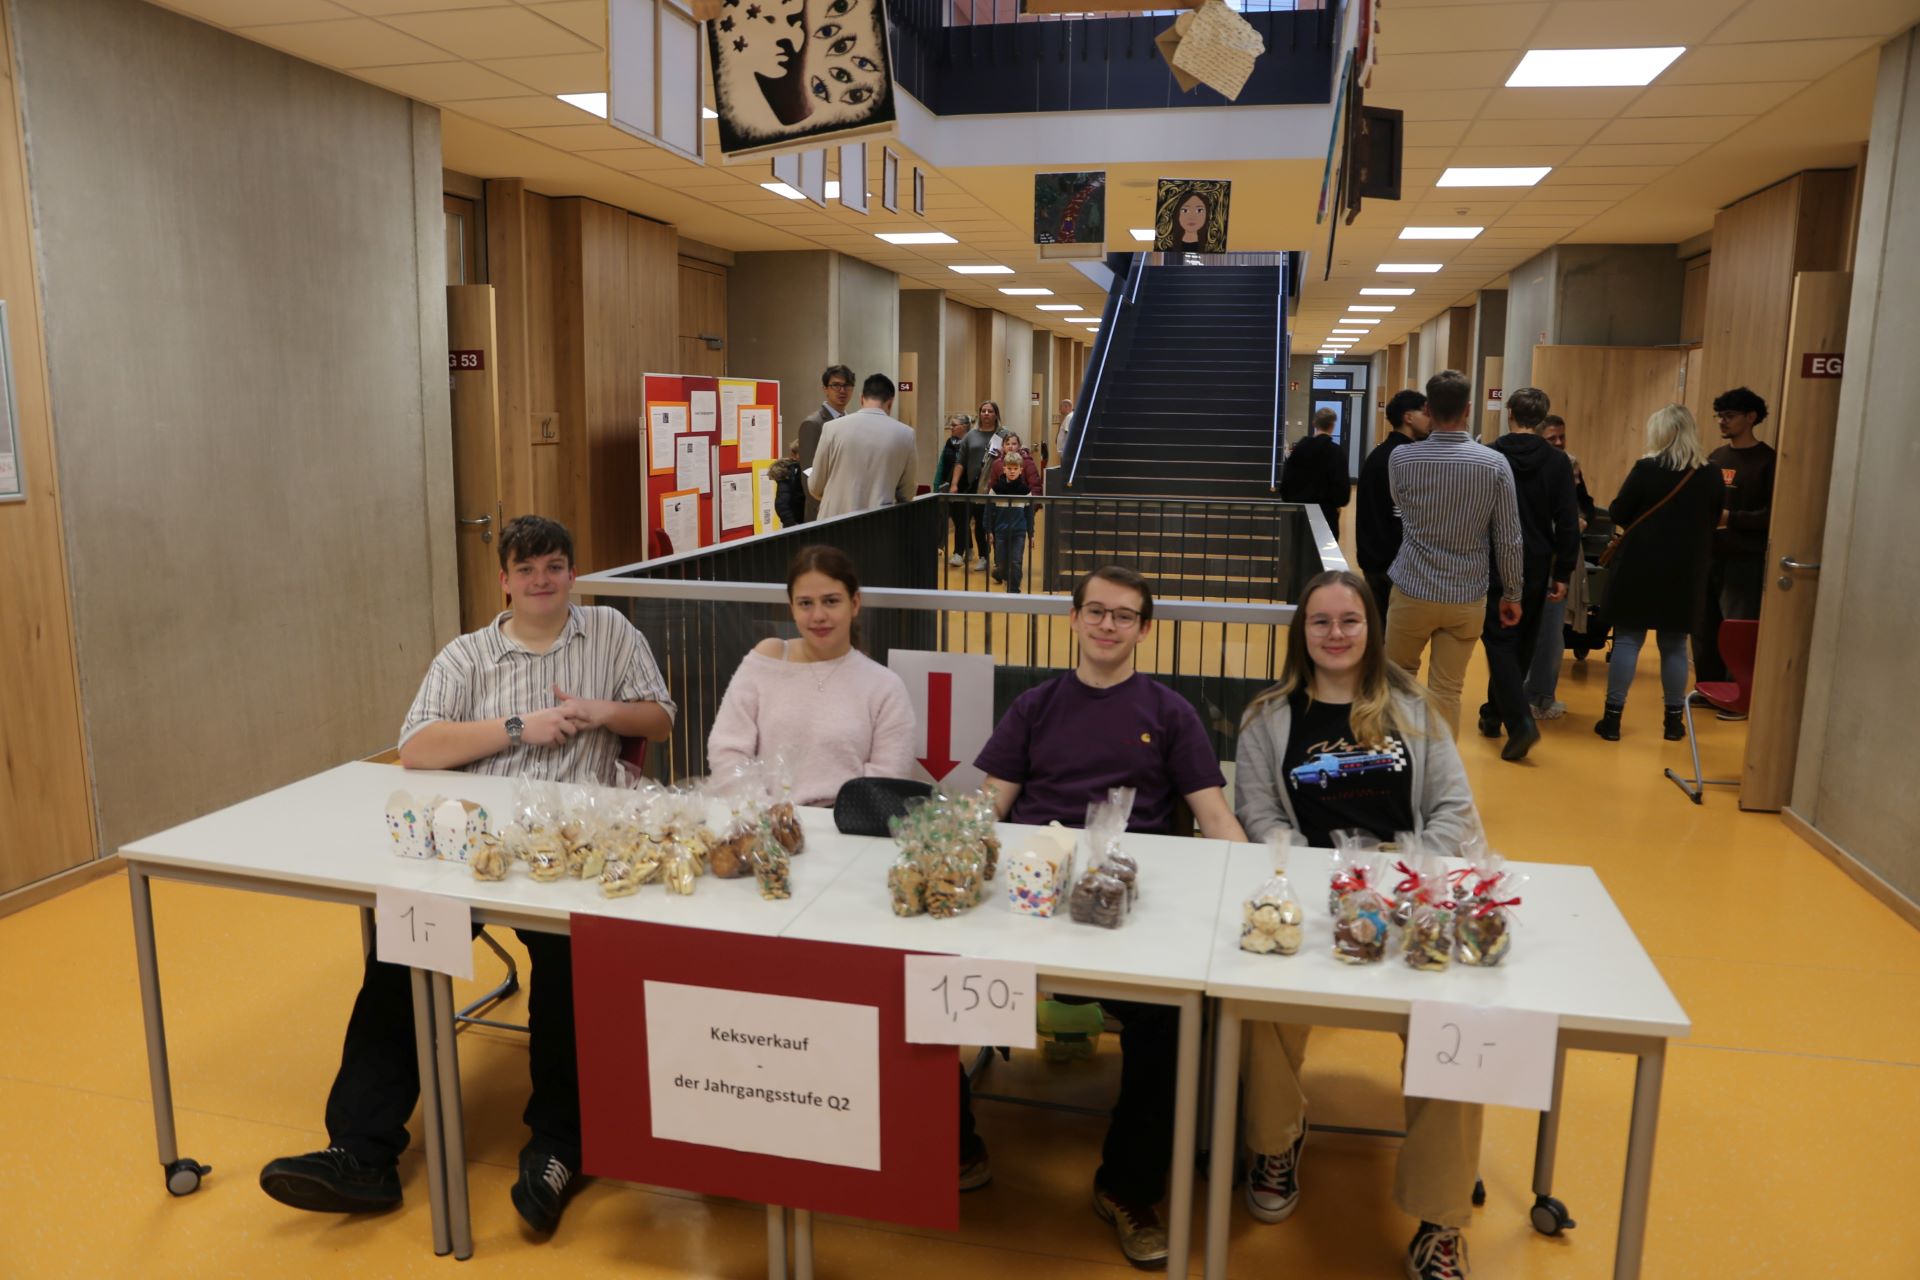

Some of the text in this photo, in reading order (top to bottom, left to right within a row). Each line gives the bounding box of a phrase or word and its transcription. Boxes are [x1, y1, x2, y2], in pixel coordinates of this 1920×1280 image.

[449, 354, 478, 367] G 53
[1812, 358, 1842, 374] EG
[710, 1026, 809, 1051] Keksverkauf
[674, 1074, 852, 1111] der Jahrgangsstufe Q2
